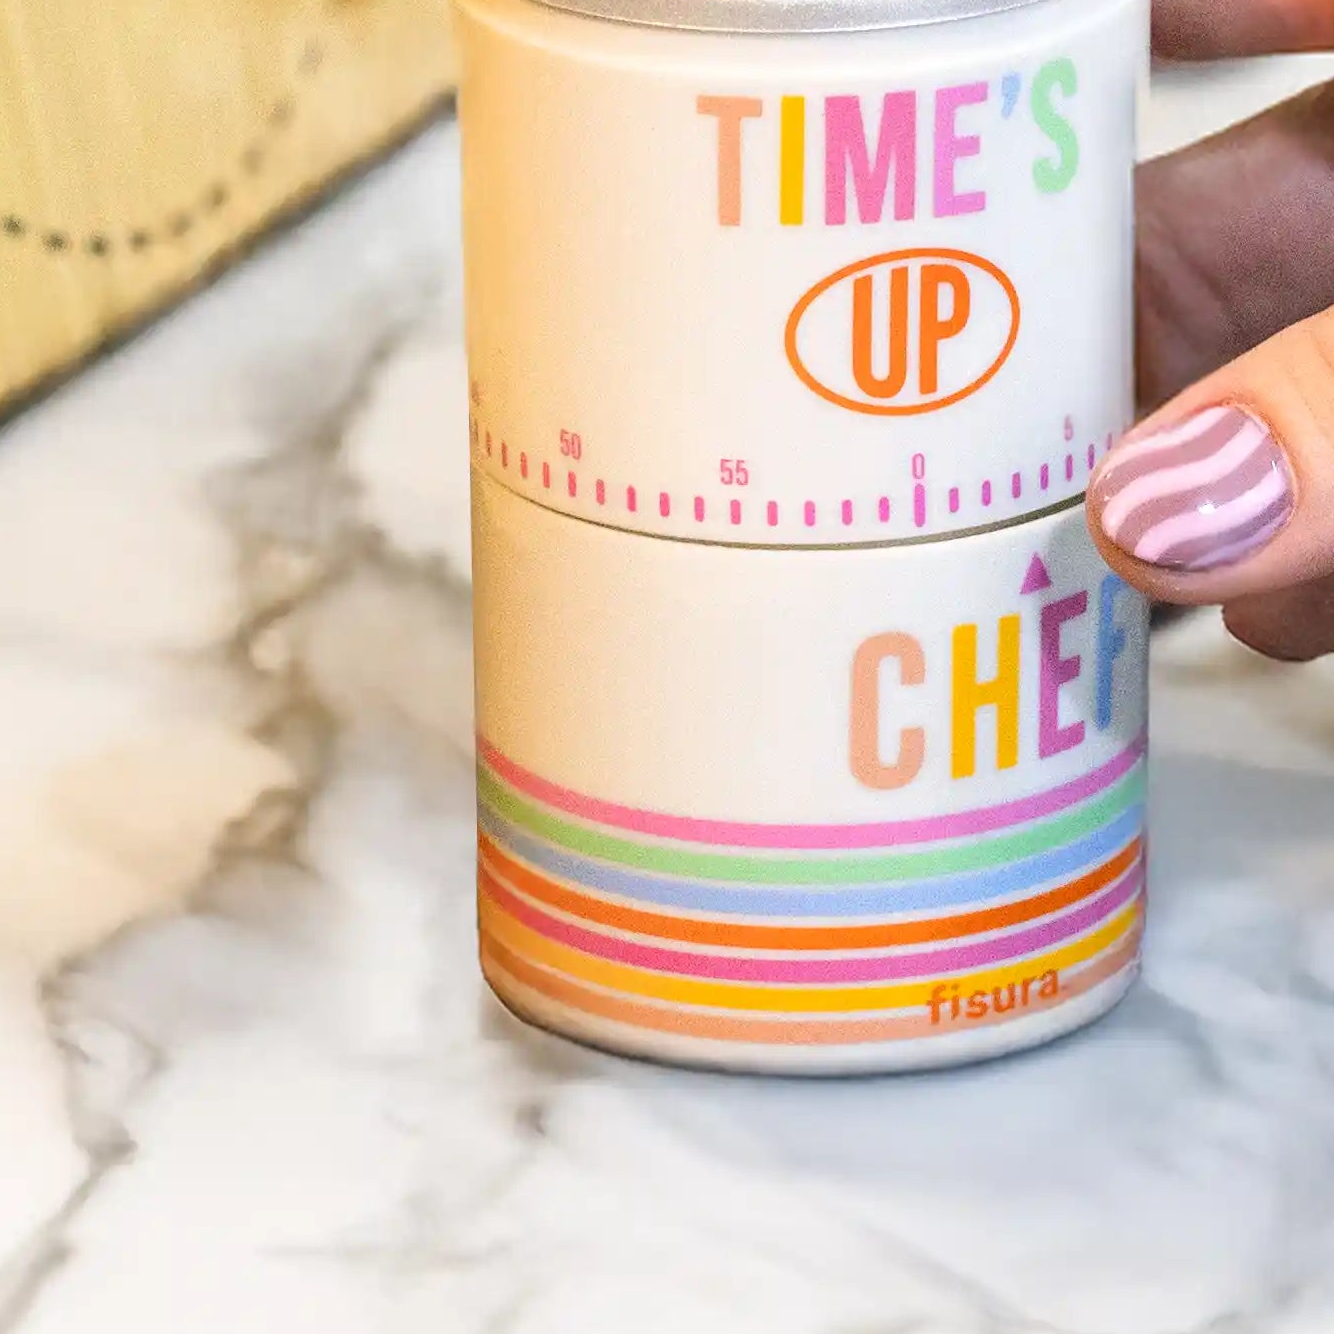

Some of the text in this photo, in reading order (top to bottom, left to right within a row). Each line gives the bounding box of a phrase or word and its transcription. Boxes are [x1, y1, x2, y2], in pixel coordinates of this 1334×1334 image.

[695, 56, 1079, 227] TIME'S
[850, 263, 972, 399] UP
[559, 427, 582, 461] 50
[719, 458, 750, 487] 55
[910, 452, 926, 481] 0
[847, 573, 1128, 793] CHEF
[926, 968, 1060, 1025] fisura
